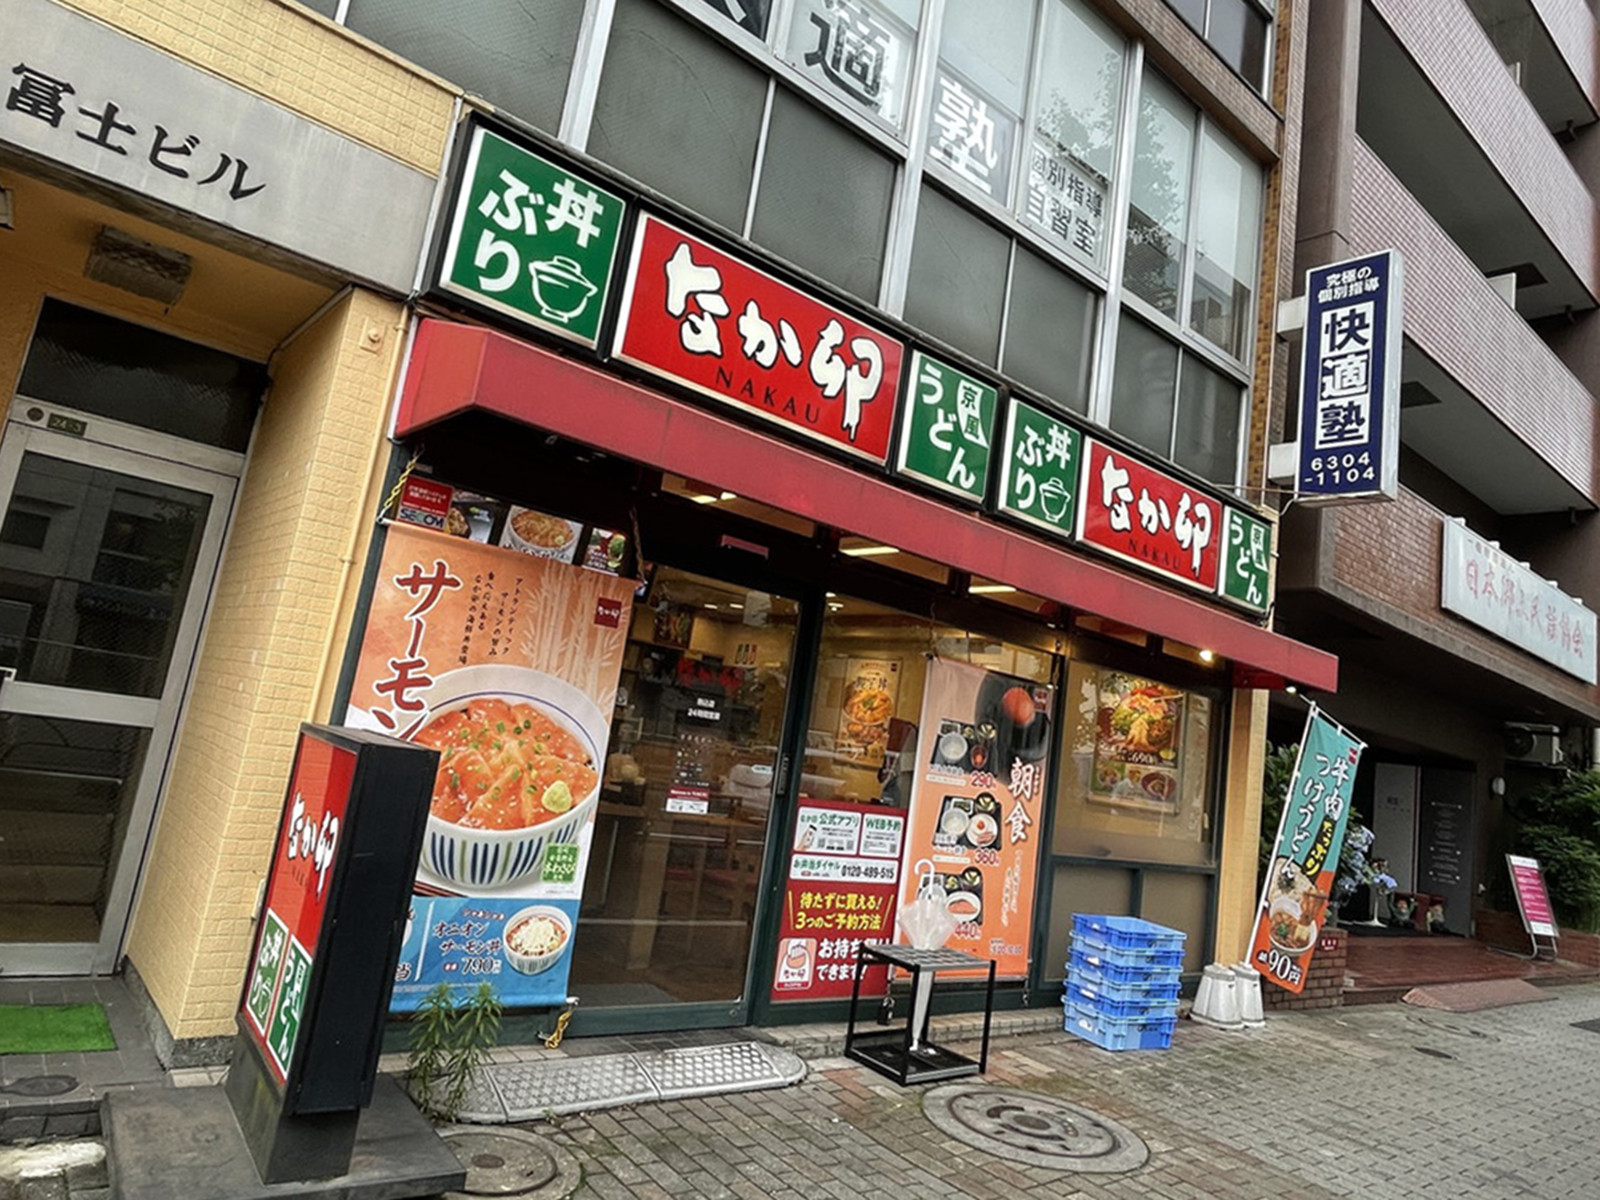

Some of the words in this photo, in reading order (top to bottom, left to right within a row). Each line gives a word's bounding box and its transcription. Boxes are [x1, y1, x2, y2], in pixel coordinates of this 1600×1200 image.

[1326, 266, 1372, 289] 究極の
[664, 242, 884, 442] なか卯
[716, 366, 820, 424] NAKAU
[1318, 307, 1371, 446] 快適塾
[920, 363, 976, 490] うどん
[1310, 452, 1371, 471] 6304
[400, 507, 444, 528] SECOM
[1101, 454, 1212, 578] なか卯
[1129, 539, 1182, 570] NAKAU
[1230, 516, 1262, 605] うどん
[1006, 757, 1035, 845] 朝食
[1281, 754, 1331, 879] つけうどん
[1325, 757, 1349, 821] 牛肉
[287, 790, 340, 903] なか卯
[841, 865, 895, 879] 0120-489-515
[795, 911, 881, 930] 3つのご予約方法
[800, 891, 883, 910] 待たずに買える!
